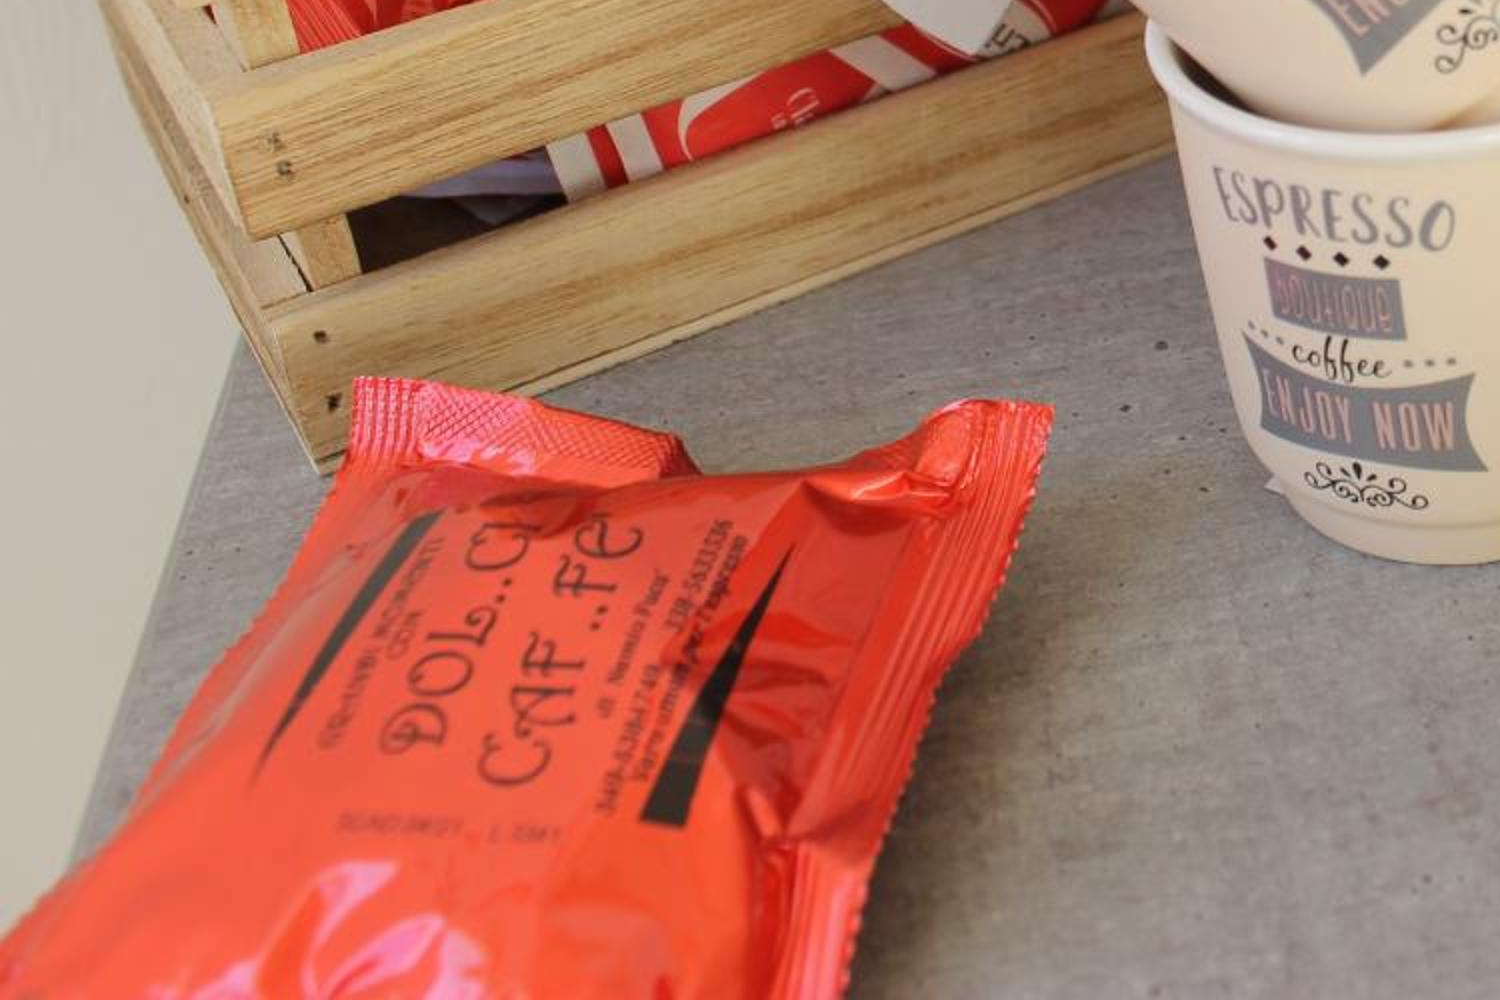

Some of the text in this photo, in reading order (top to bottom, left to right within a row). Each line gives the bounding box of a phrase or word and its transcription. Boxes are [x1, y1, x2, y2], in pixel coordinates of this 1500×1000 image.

[1212, 165, 1457, 252] ESPRESSO
[1291, 335, 1393, 383] coffee
[1262, 368, 1456, 451] ENJOY NOW
